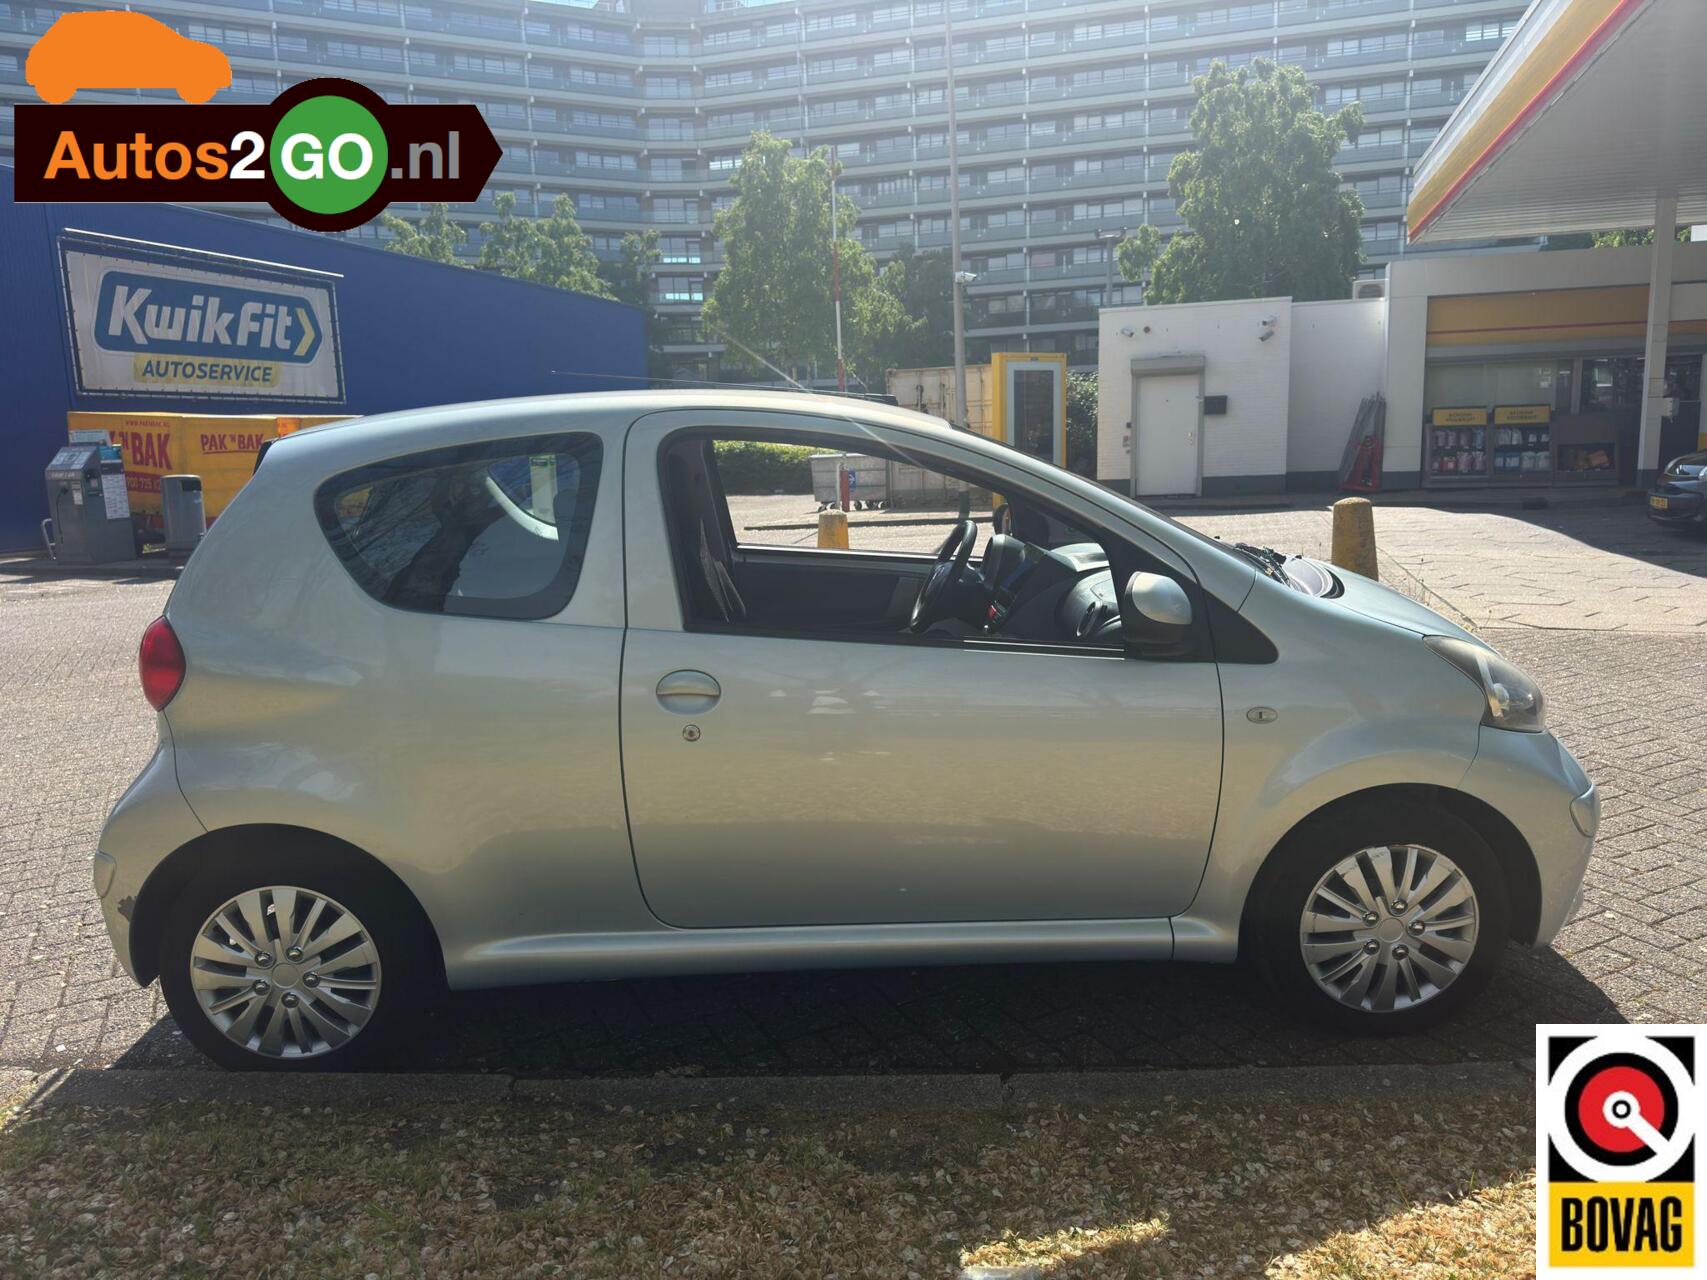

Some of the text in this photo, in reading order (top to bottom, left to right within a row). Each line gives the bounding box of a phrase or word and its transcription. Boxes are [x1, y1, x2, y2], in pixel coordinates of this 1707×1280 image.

[142, 360, 273, 382] AUTOSERVICE
[131, 431, 173, 471] BAK
[200, 433, 228, 451] PAK
